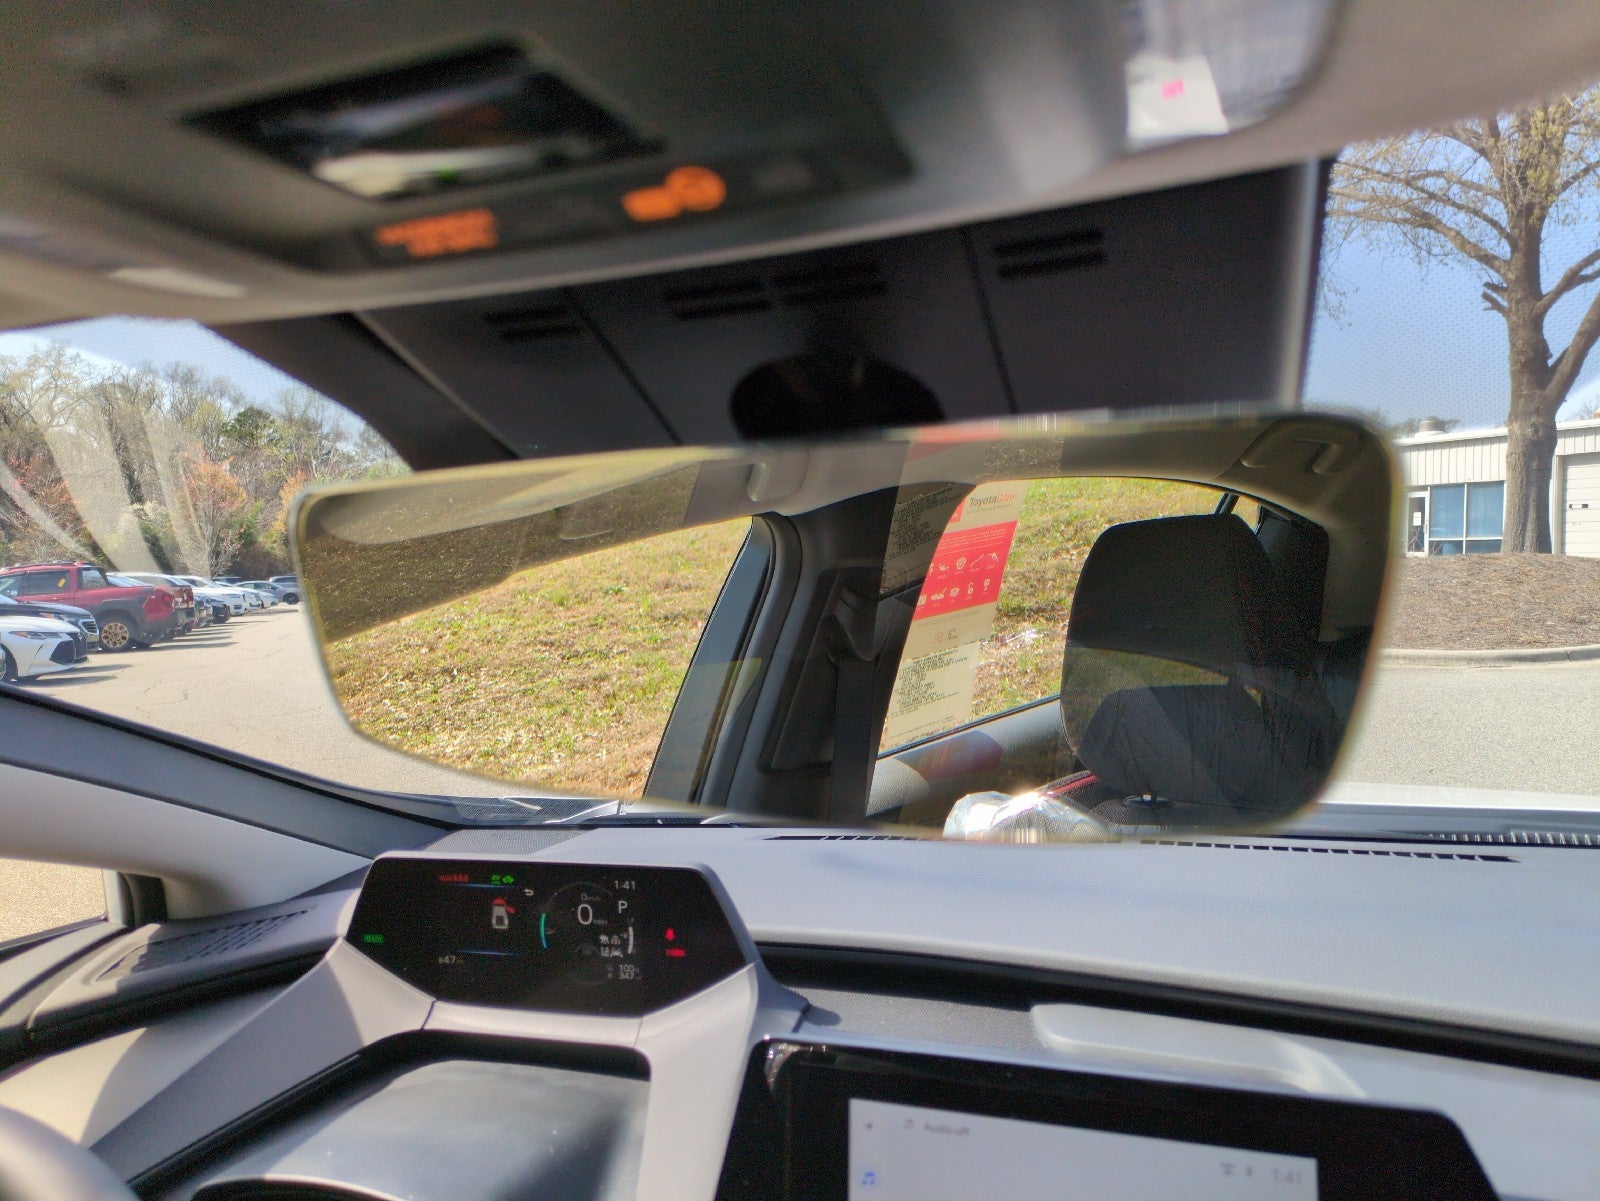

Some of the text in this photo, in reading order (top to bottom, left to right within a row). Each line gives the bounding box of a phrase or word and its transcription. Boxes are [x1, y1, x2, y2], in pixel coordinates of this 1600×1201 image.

[614, 880, 636, 890] 1:41
[577, 903, 593, 925] 0
[617, 900, 628, 914] P
